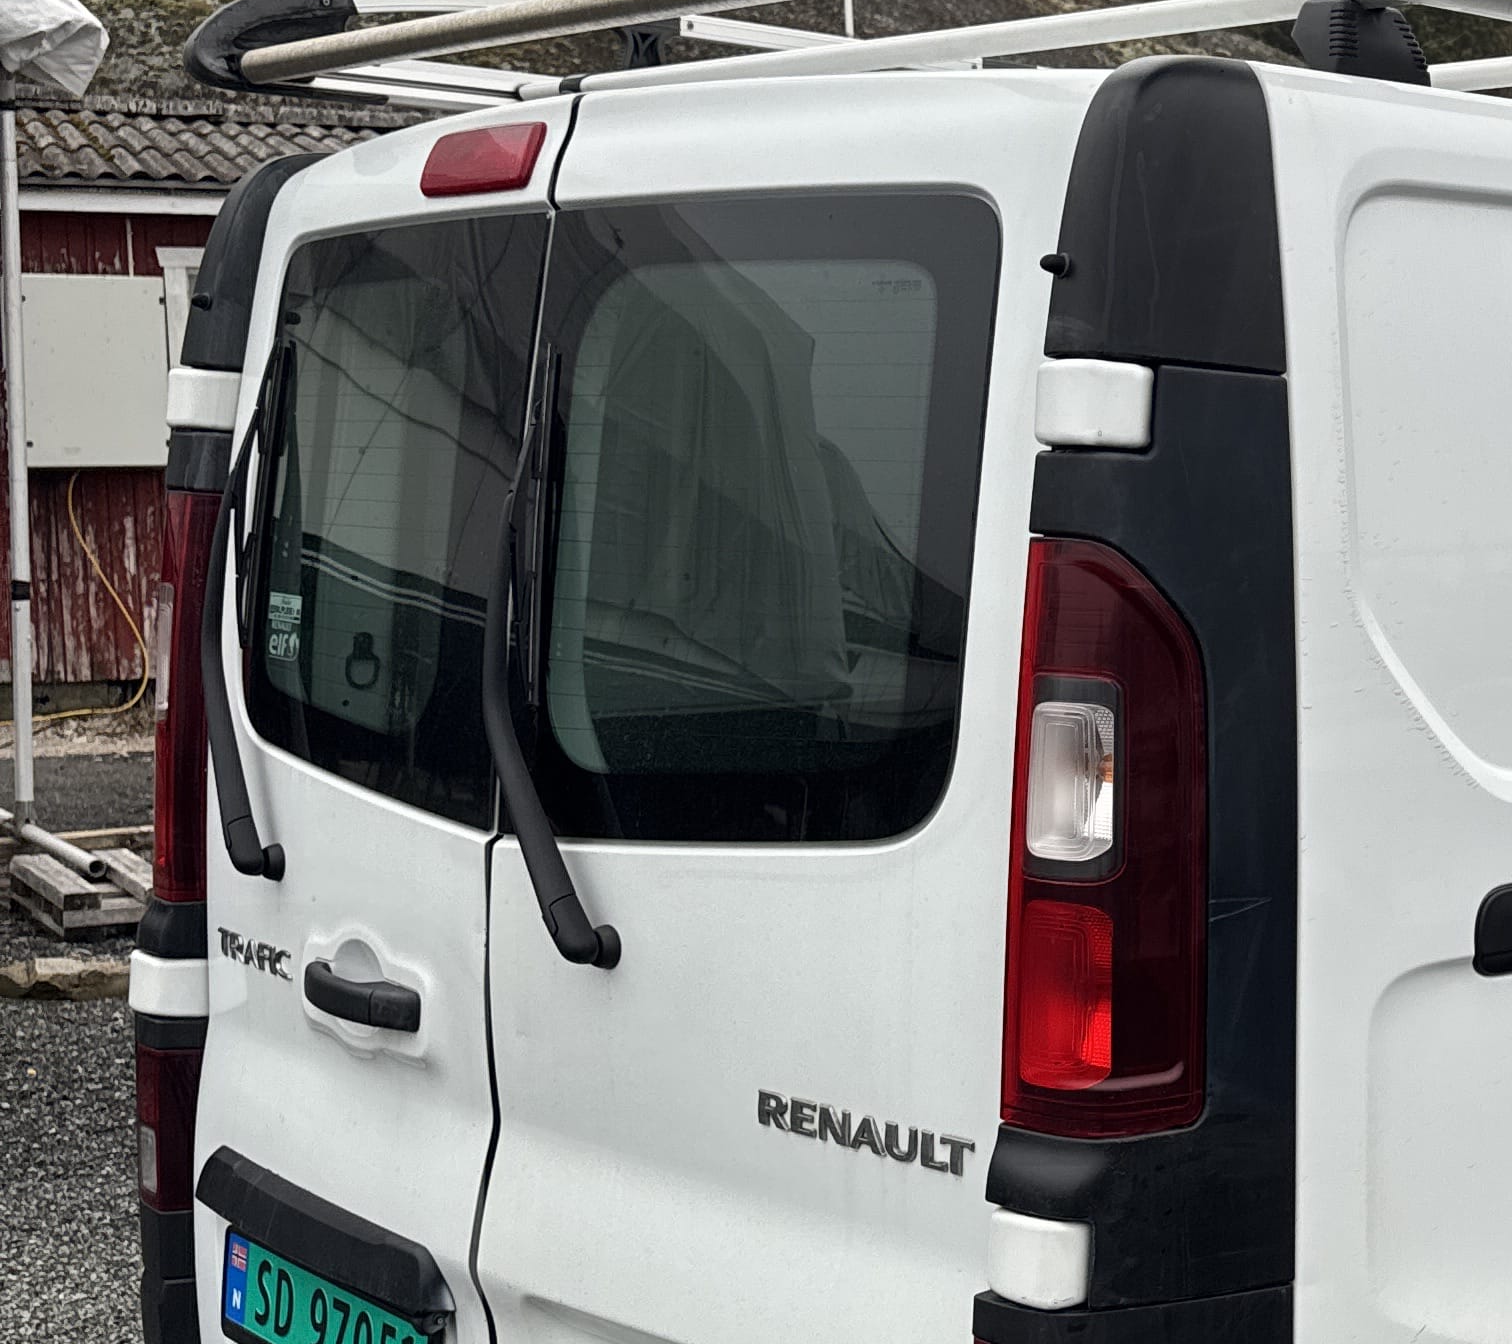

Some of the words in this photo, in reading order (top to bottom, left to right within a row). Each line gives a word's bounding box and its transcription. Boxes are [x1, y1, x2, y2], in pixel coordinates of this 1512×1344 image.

[269, 633, 289, 657] elf
[218, 926, 294, 982] TRAFIC
[757, 1088, 976, 1177] RENAULT
[231, 1287, 242, 1310] N
[254, 1258, 294, 1338] SD
